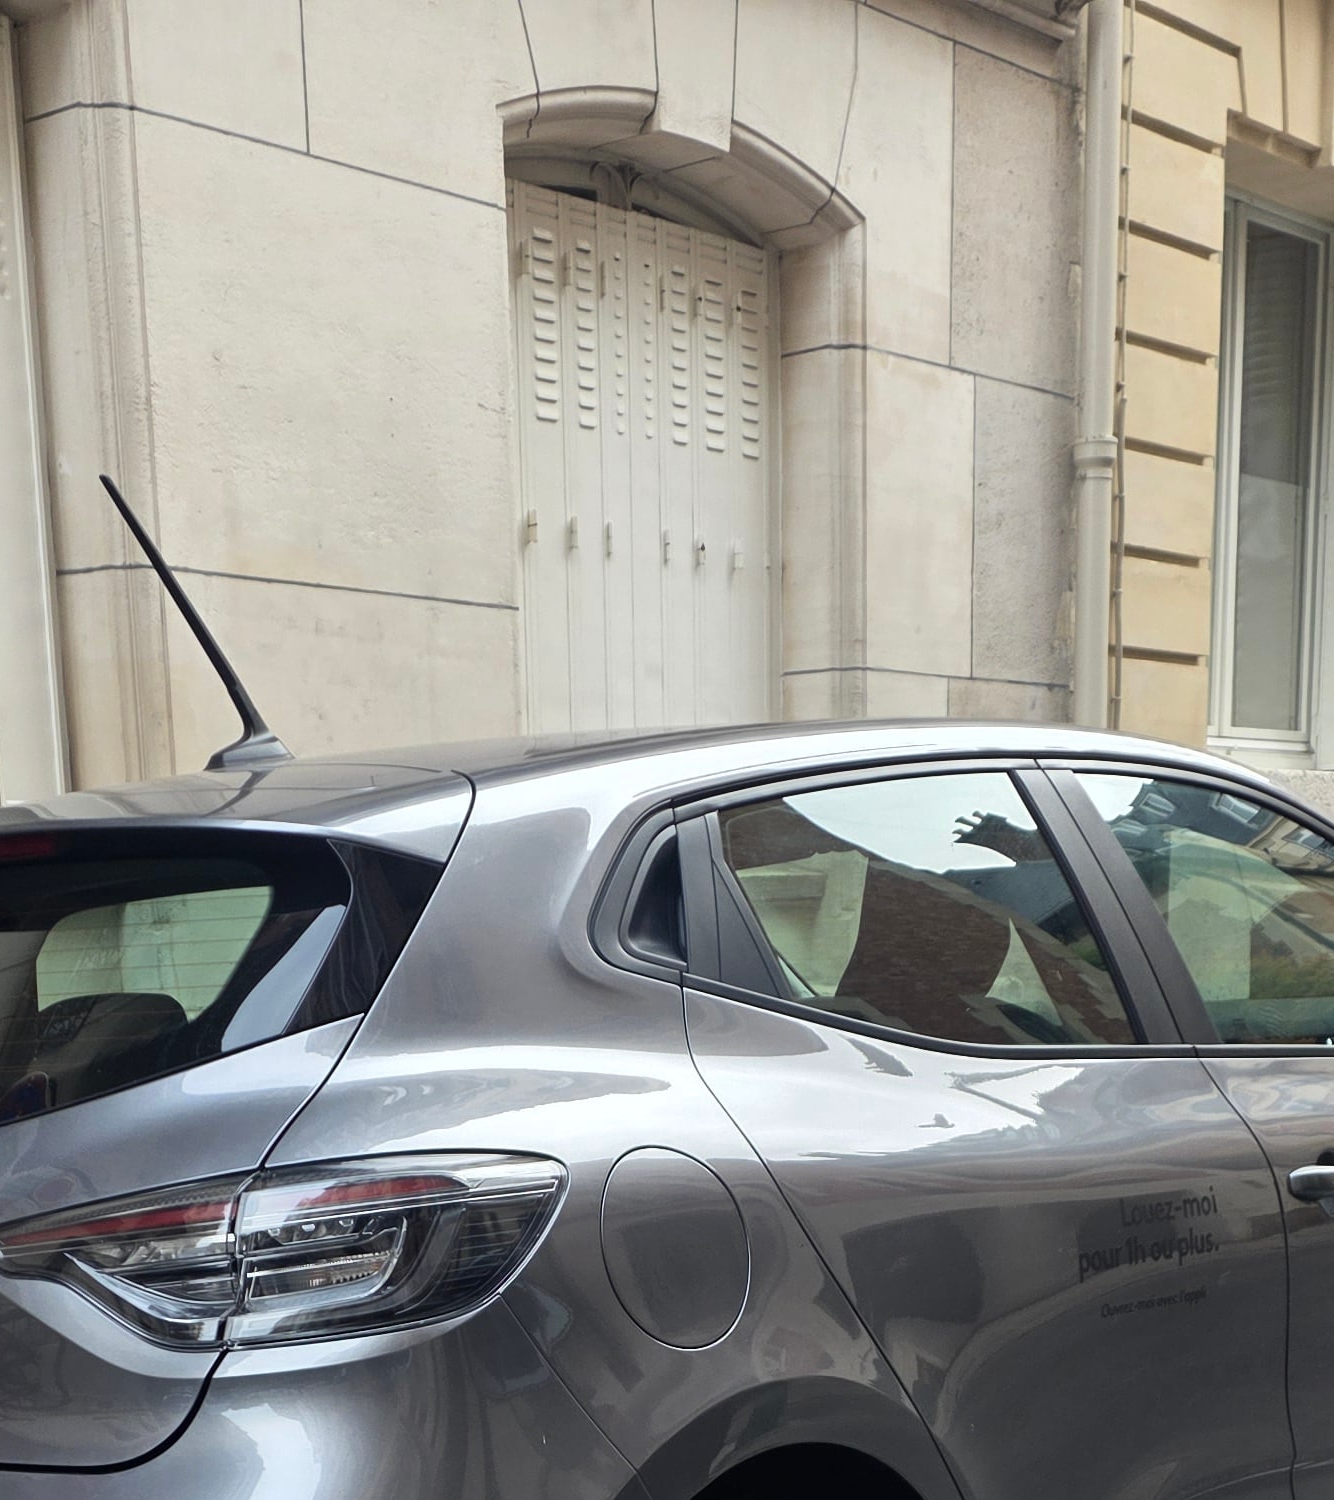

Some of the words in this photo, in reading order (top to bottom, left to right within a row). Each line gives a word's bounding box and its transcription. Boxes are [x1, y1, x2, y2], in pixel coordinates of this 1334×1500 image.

[1119, 1184, 1218, 1228] Louez-moi
[1078, 1245, 1123, 1284] pour
[1125, 1236, 1147, 1266] 1h
[1150, 1239, 1174, 1262] ou
[1178, 1227, 1220, 1266] plus.
